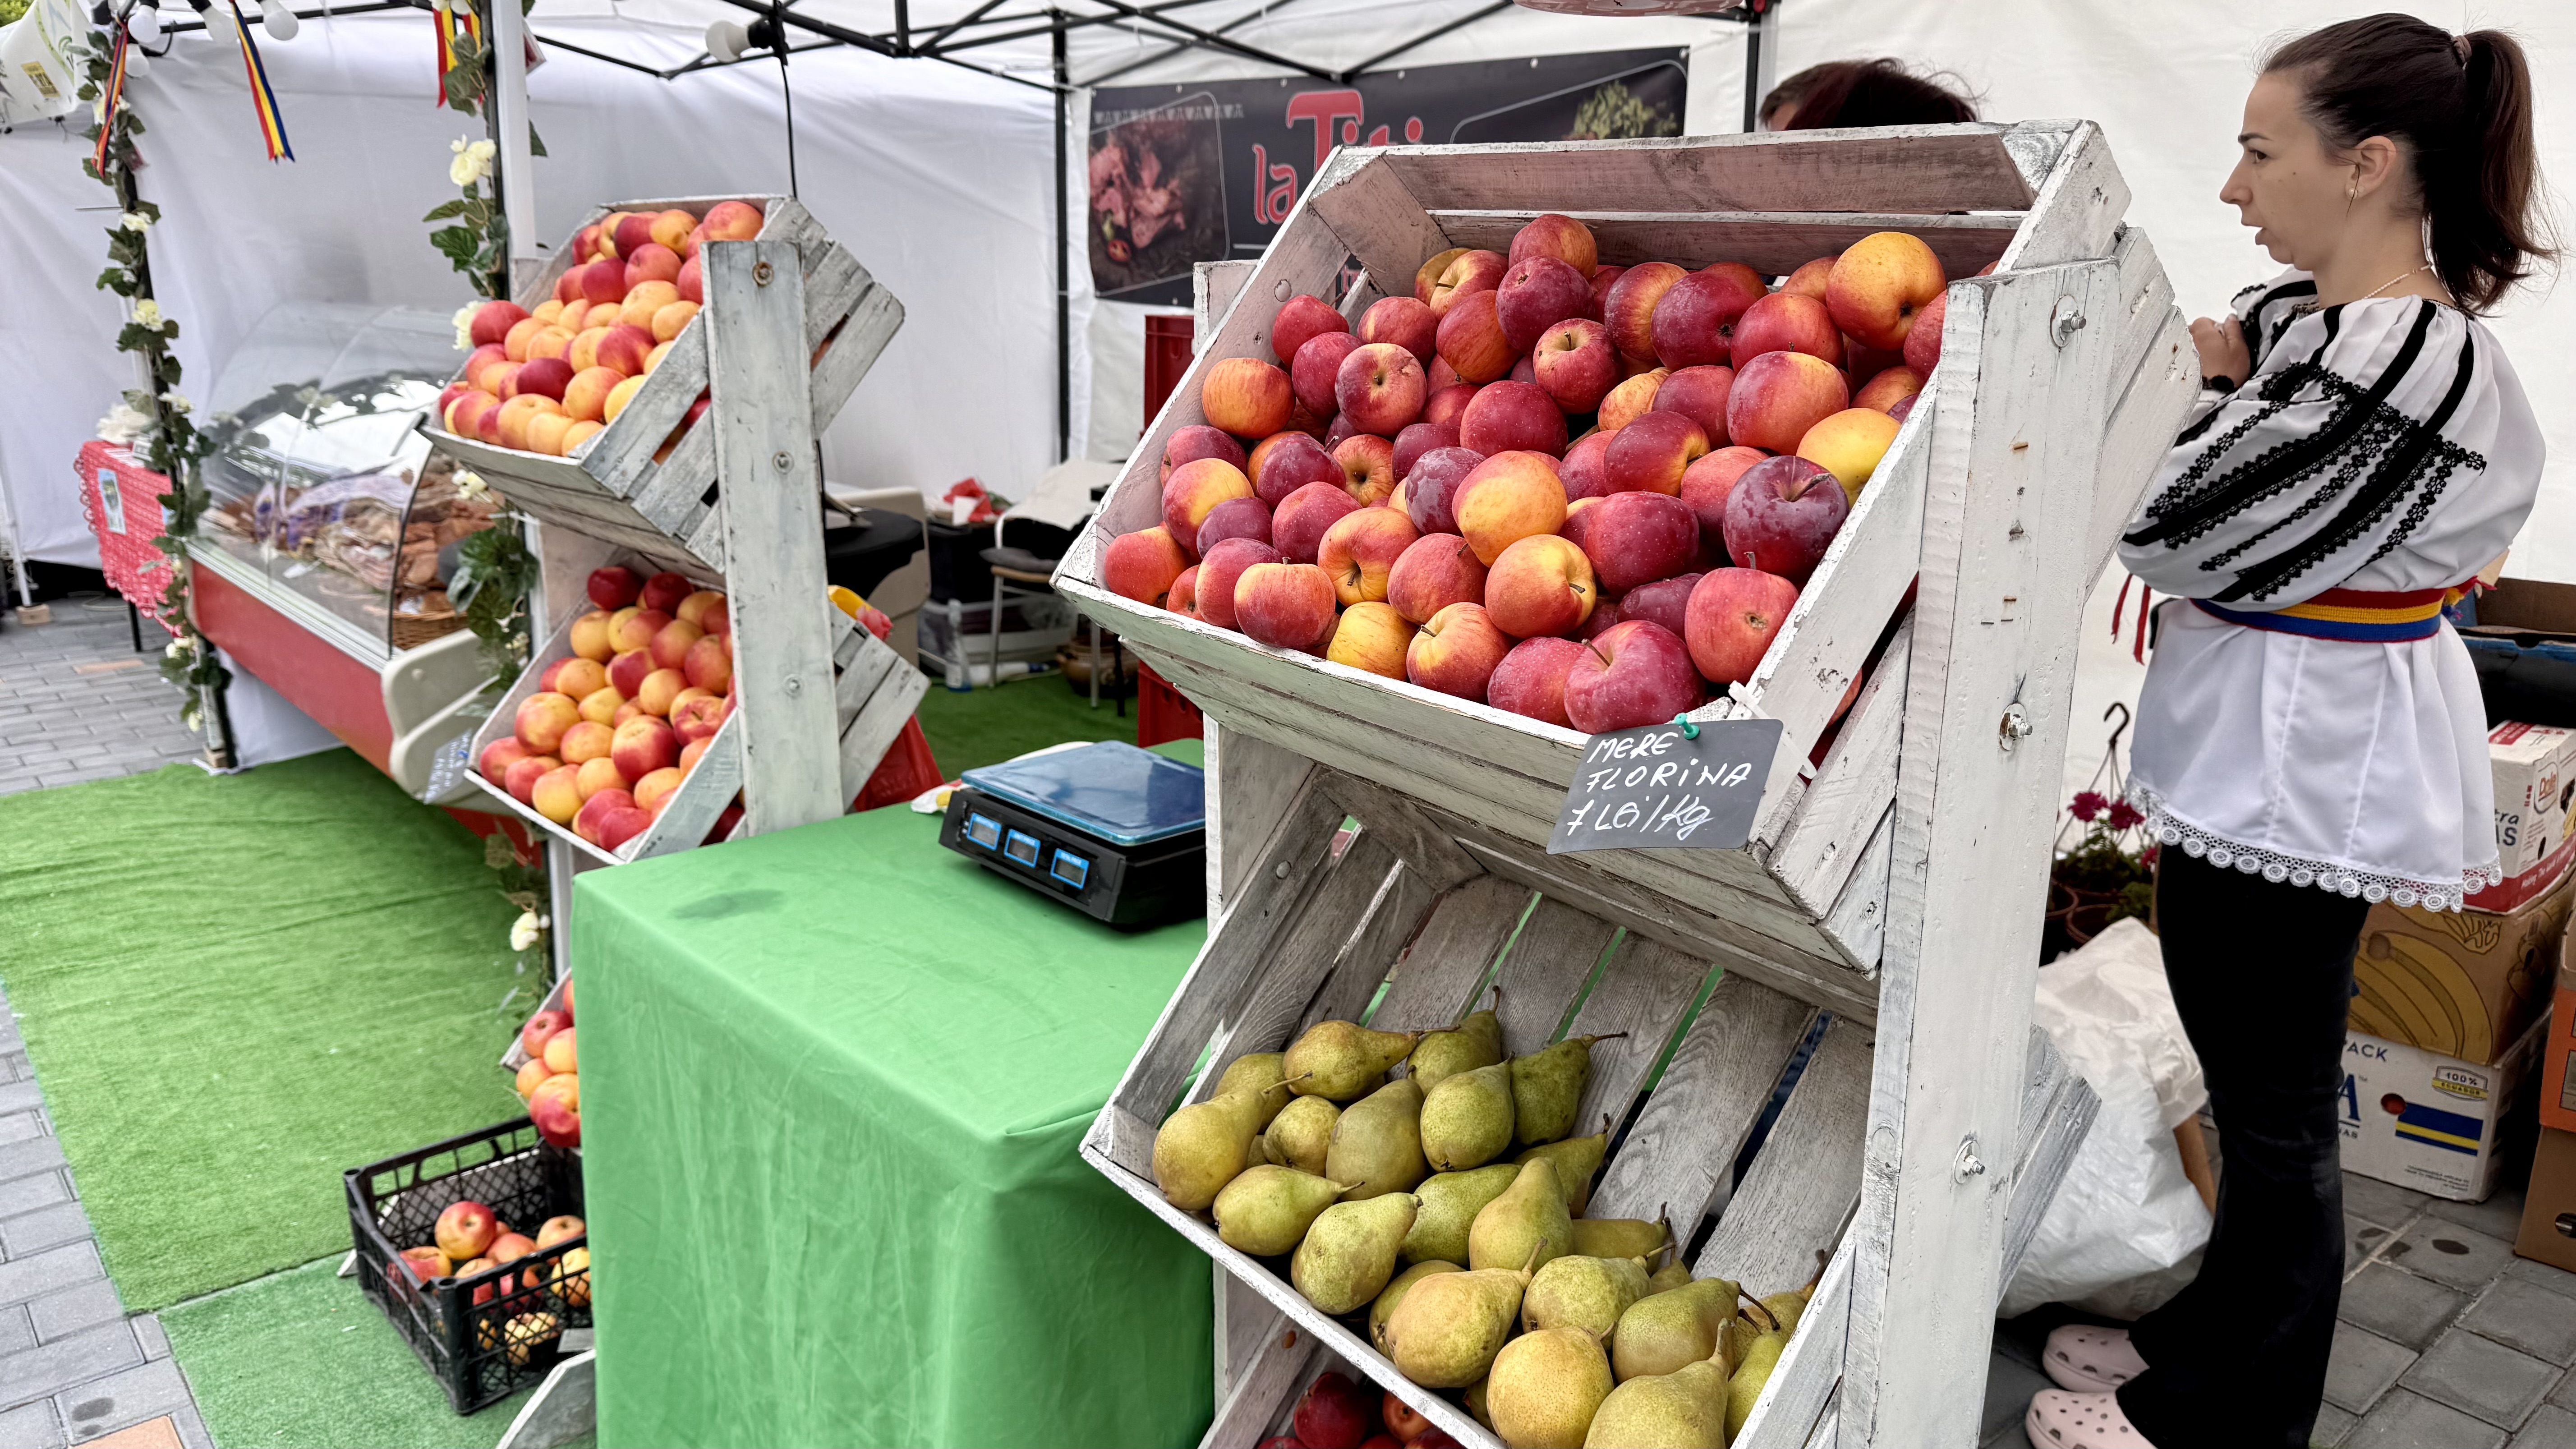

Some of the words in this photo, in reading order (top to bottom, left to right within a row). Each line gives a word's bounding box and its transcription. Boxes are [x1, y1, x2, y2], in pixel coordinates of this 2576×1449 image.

[1587, 732, 1679, 764] MERE
[1567, 799, 1595, 837] 7
[2344, 1040, 2388, 1062] ACK
[2446, 1072, 2477, 1086] 100%
